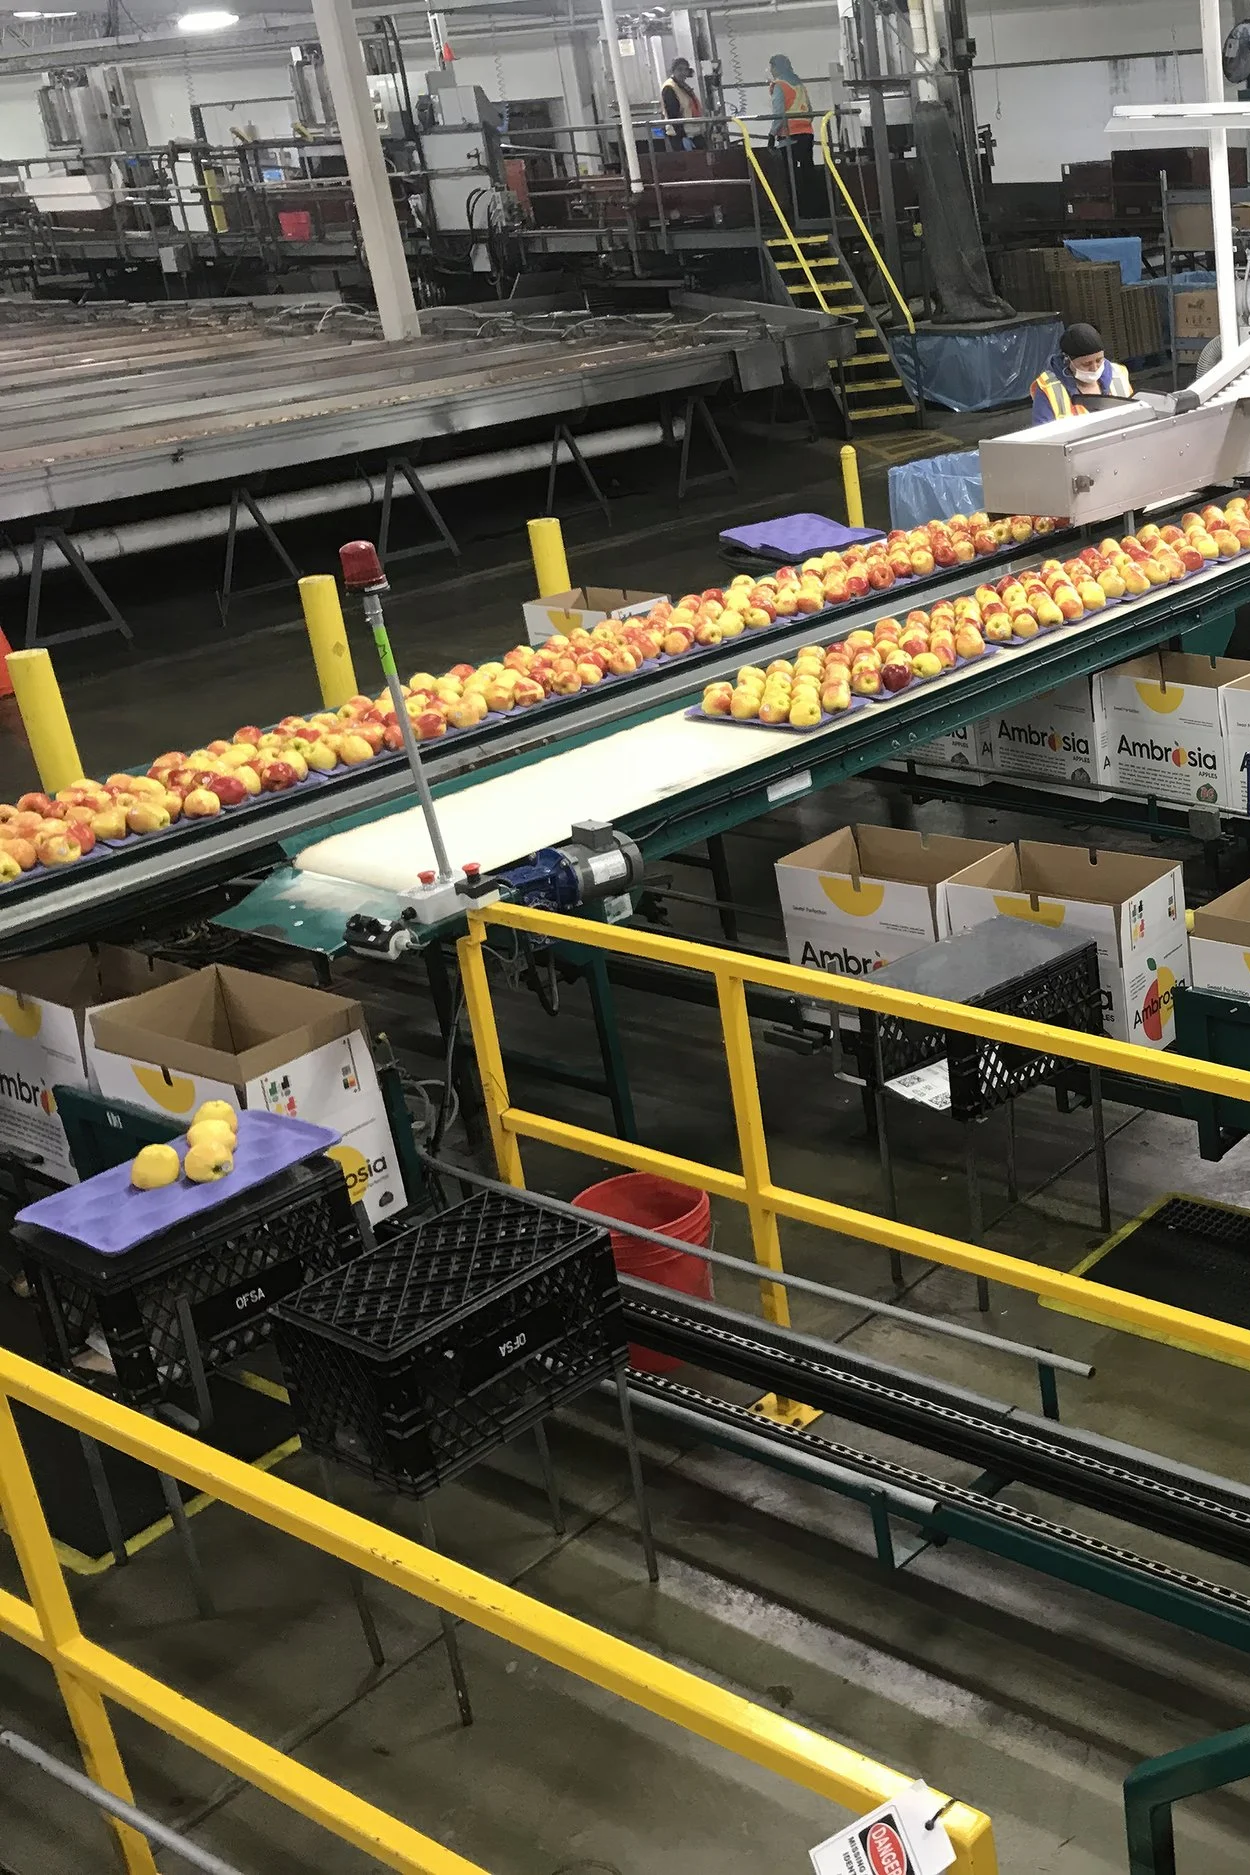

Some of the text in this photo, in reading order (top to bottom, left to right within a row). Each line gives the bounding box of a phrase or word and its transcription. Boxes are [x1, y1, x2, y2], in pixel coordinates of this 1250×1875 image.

[1117, 734, 1217, 771] Ambrosia
[1198, 770, 1218, 780] APPLES
[345, 1155, 388, 1189] osia
[235, 1287, 266, 1310] OFSA
[498, 1332, 527, 1357] OFSA
